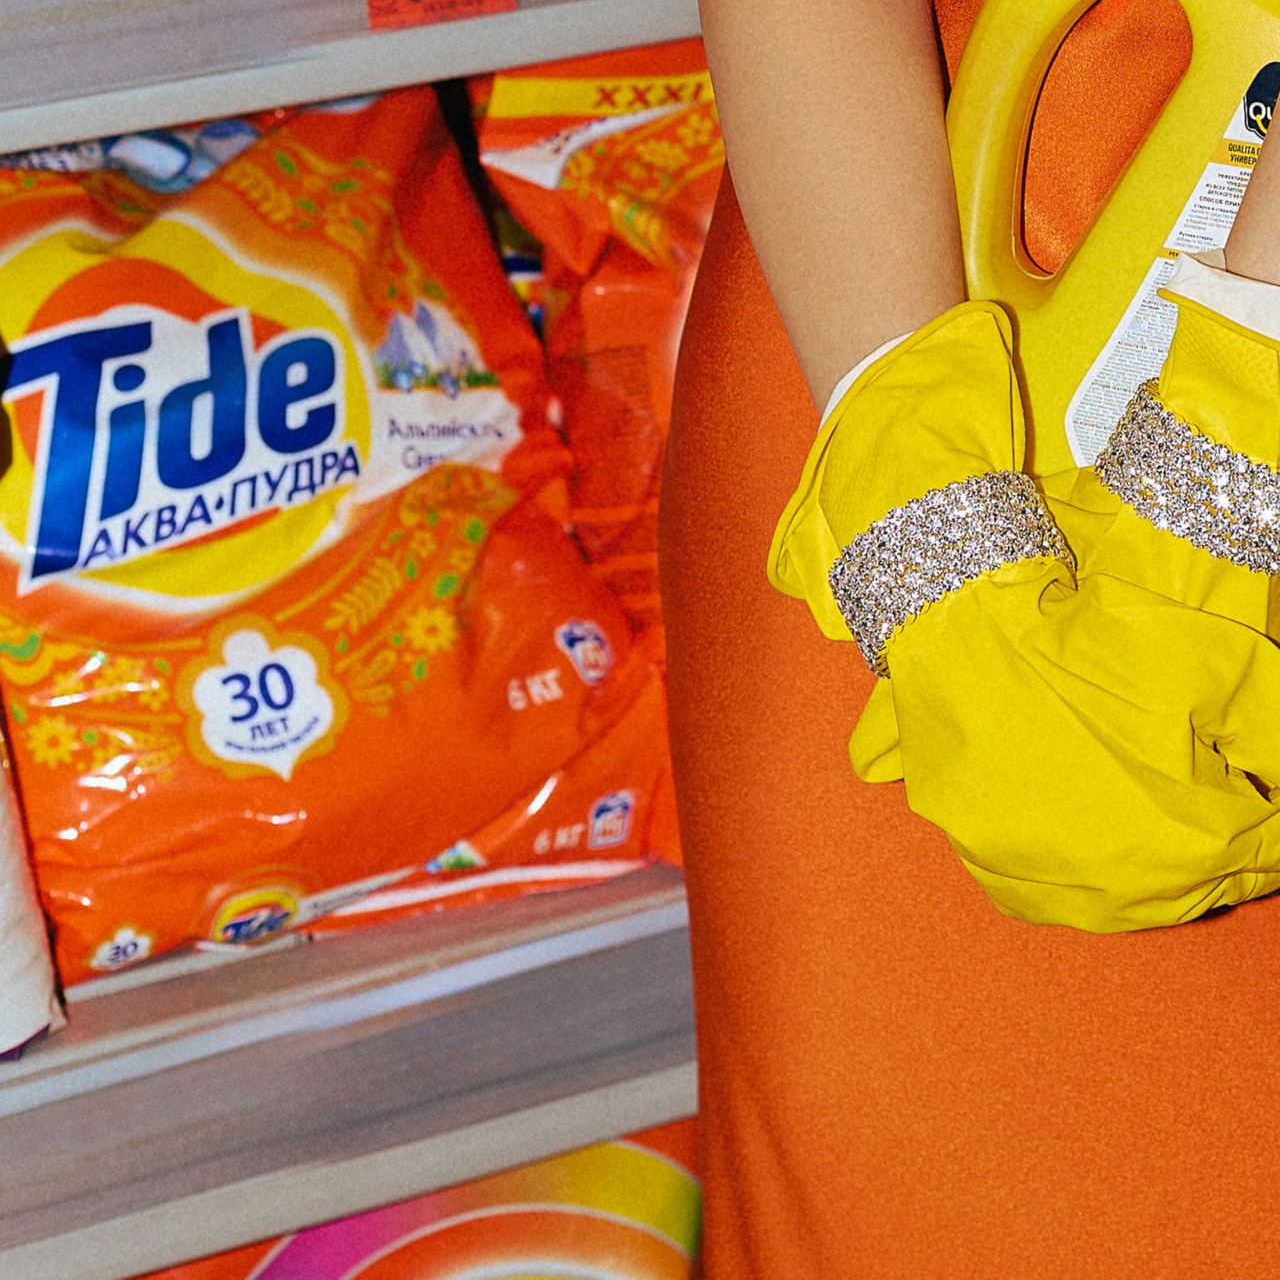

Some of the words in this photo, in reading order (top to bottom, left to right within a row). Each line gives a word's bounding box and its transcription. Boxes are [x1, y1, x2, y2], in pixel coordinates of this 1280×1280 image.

[7, 317, 337, 580] Tide
[222, 662, 294, 722] 30
[250, 717, 289, 740] ЛЕТ
